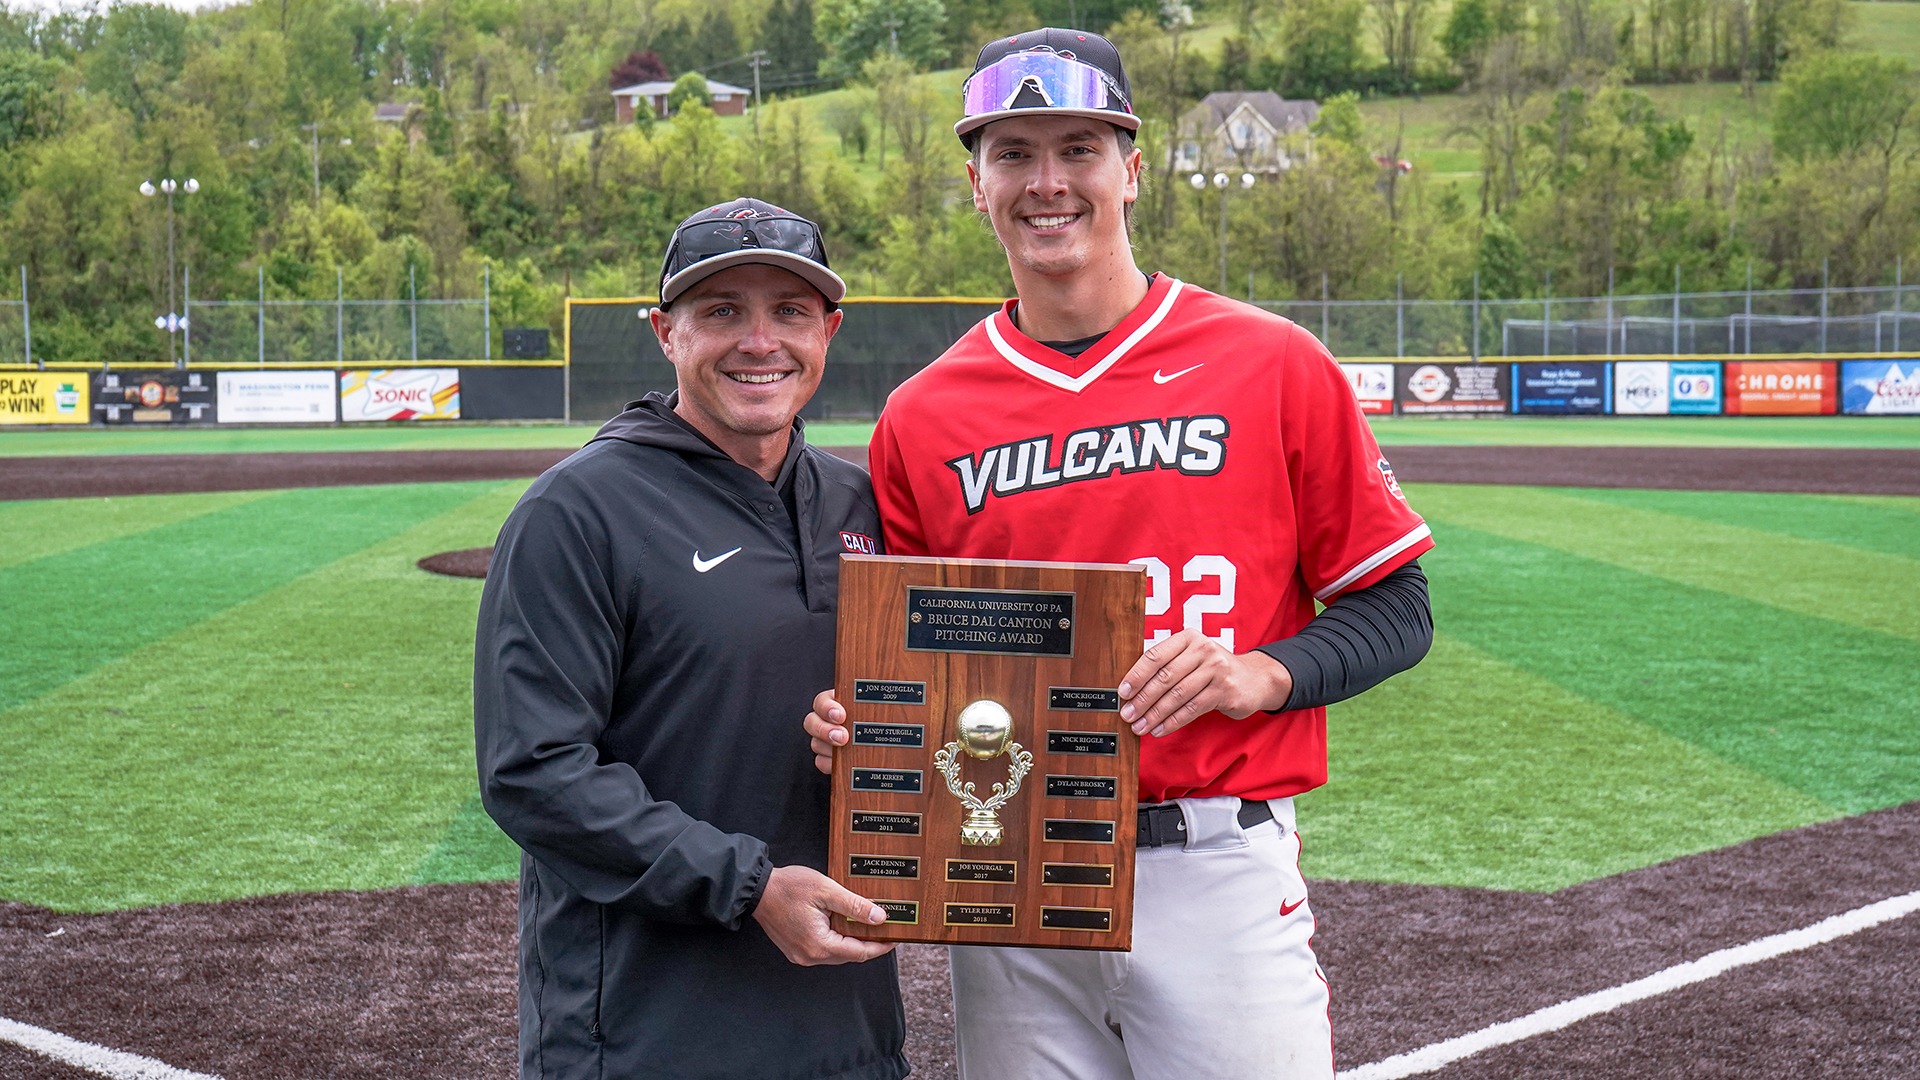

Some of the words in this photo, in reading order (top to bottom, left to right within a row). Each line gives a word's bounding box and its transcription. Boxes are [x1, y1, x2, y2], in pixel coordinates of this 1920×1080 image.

[0, 378, 38, 394] PLAY
[1735, 374, 1824, 390] CHROME
[373, 388, 427, 403] SONIC
[8, 397, 45, 414] WIN!
[950, 416, 1229, 513] VULCANS
[842, 534, 868, 554] CAL
[919, 598, 977, 610] CALIFORNIA
[978, 601, 1034, 612] UNIVERSITY
[1036, 604, 1048, 612] OF
[1050, 604, 1062, 613] PA
[1128, 555, 1237, 653] 22
[928, 614, 968, 626] BRUCE
[970, 616, 996, 627] DAL
[998, 617, 1052, 630] CANTON
[935, 630, 996, 642] PITCHING
[998, 632, 1044, 644] AWARD
[865, 684, 880, 692] JON
[880, 685, 914, 693] SQUEGLIA
[886, 816, 911, 824] TAYLOR
